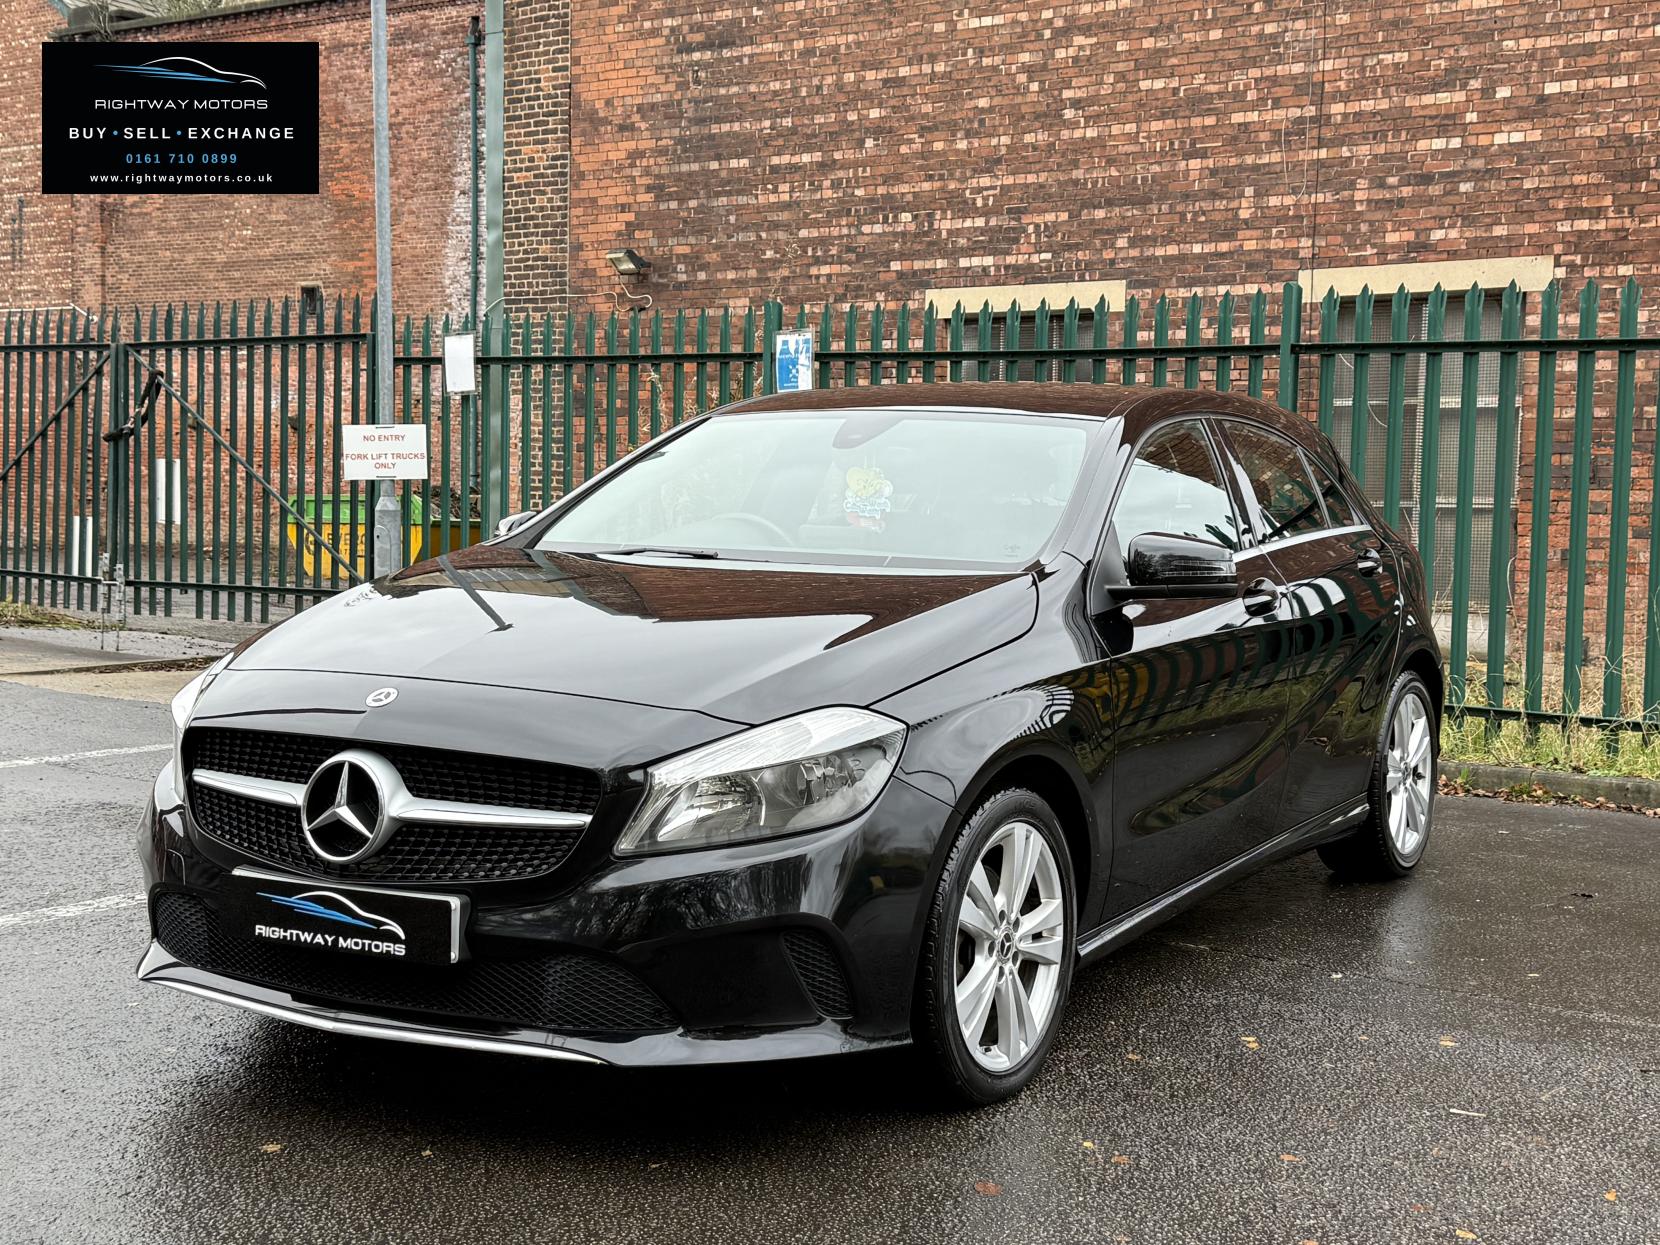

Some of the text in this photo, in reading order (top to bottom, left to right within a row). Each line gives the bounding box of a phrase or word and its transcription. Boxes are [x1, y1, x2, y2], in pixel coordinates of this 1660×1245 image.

[363, 434, 406, 442] NO ENTRY
[345, 453, 369, 461] FORK
[390, 452, 426, 460] TRUCKS
[255, 924, 406, 956] RIGHTWAY MOTORS
